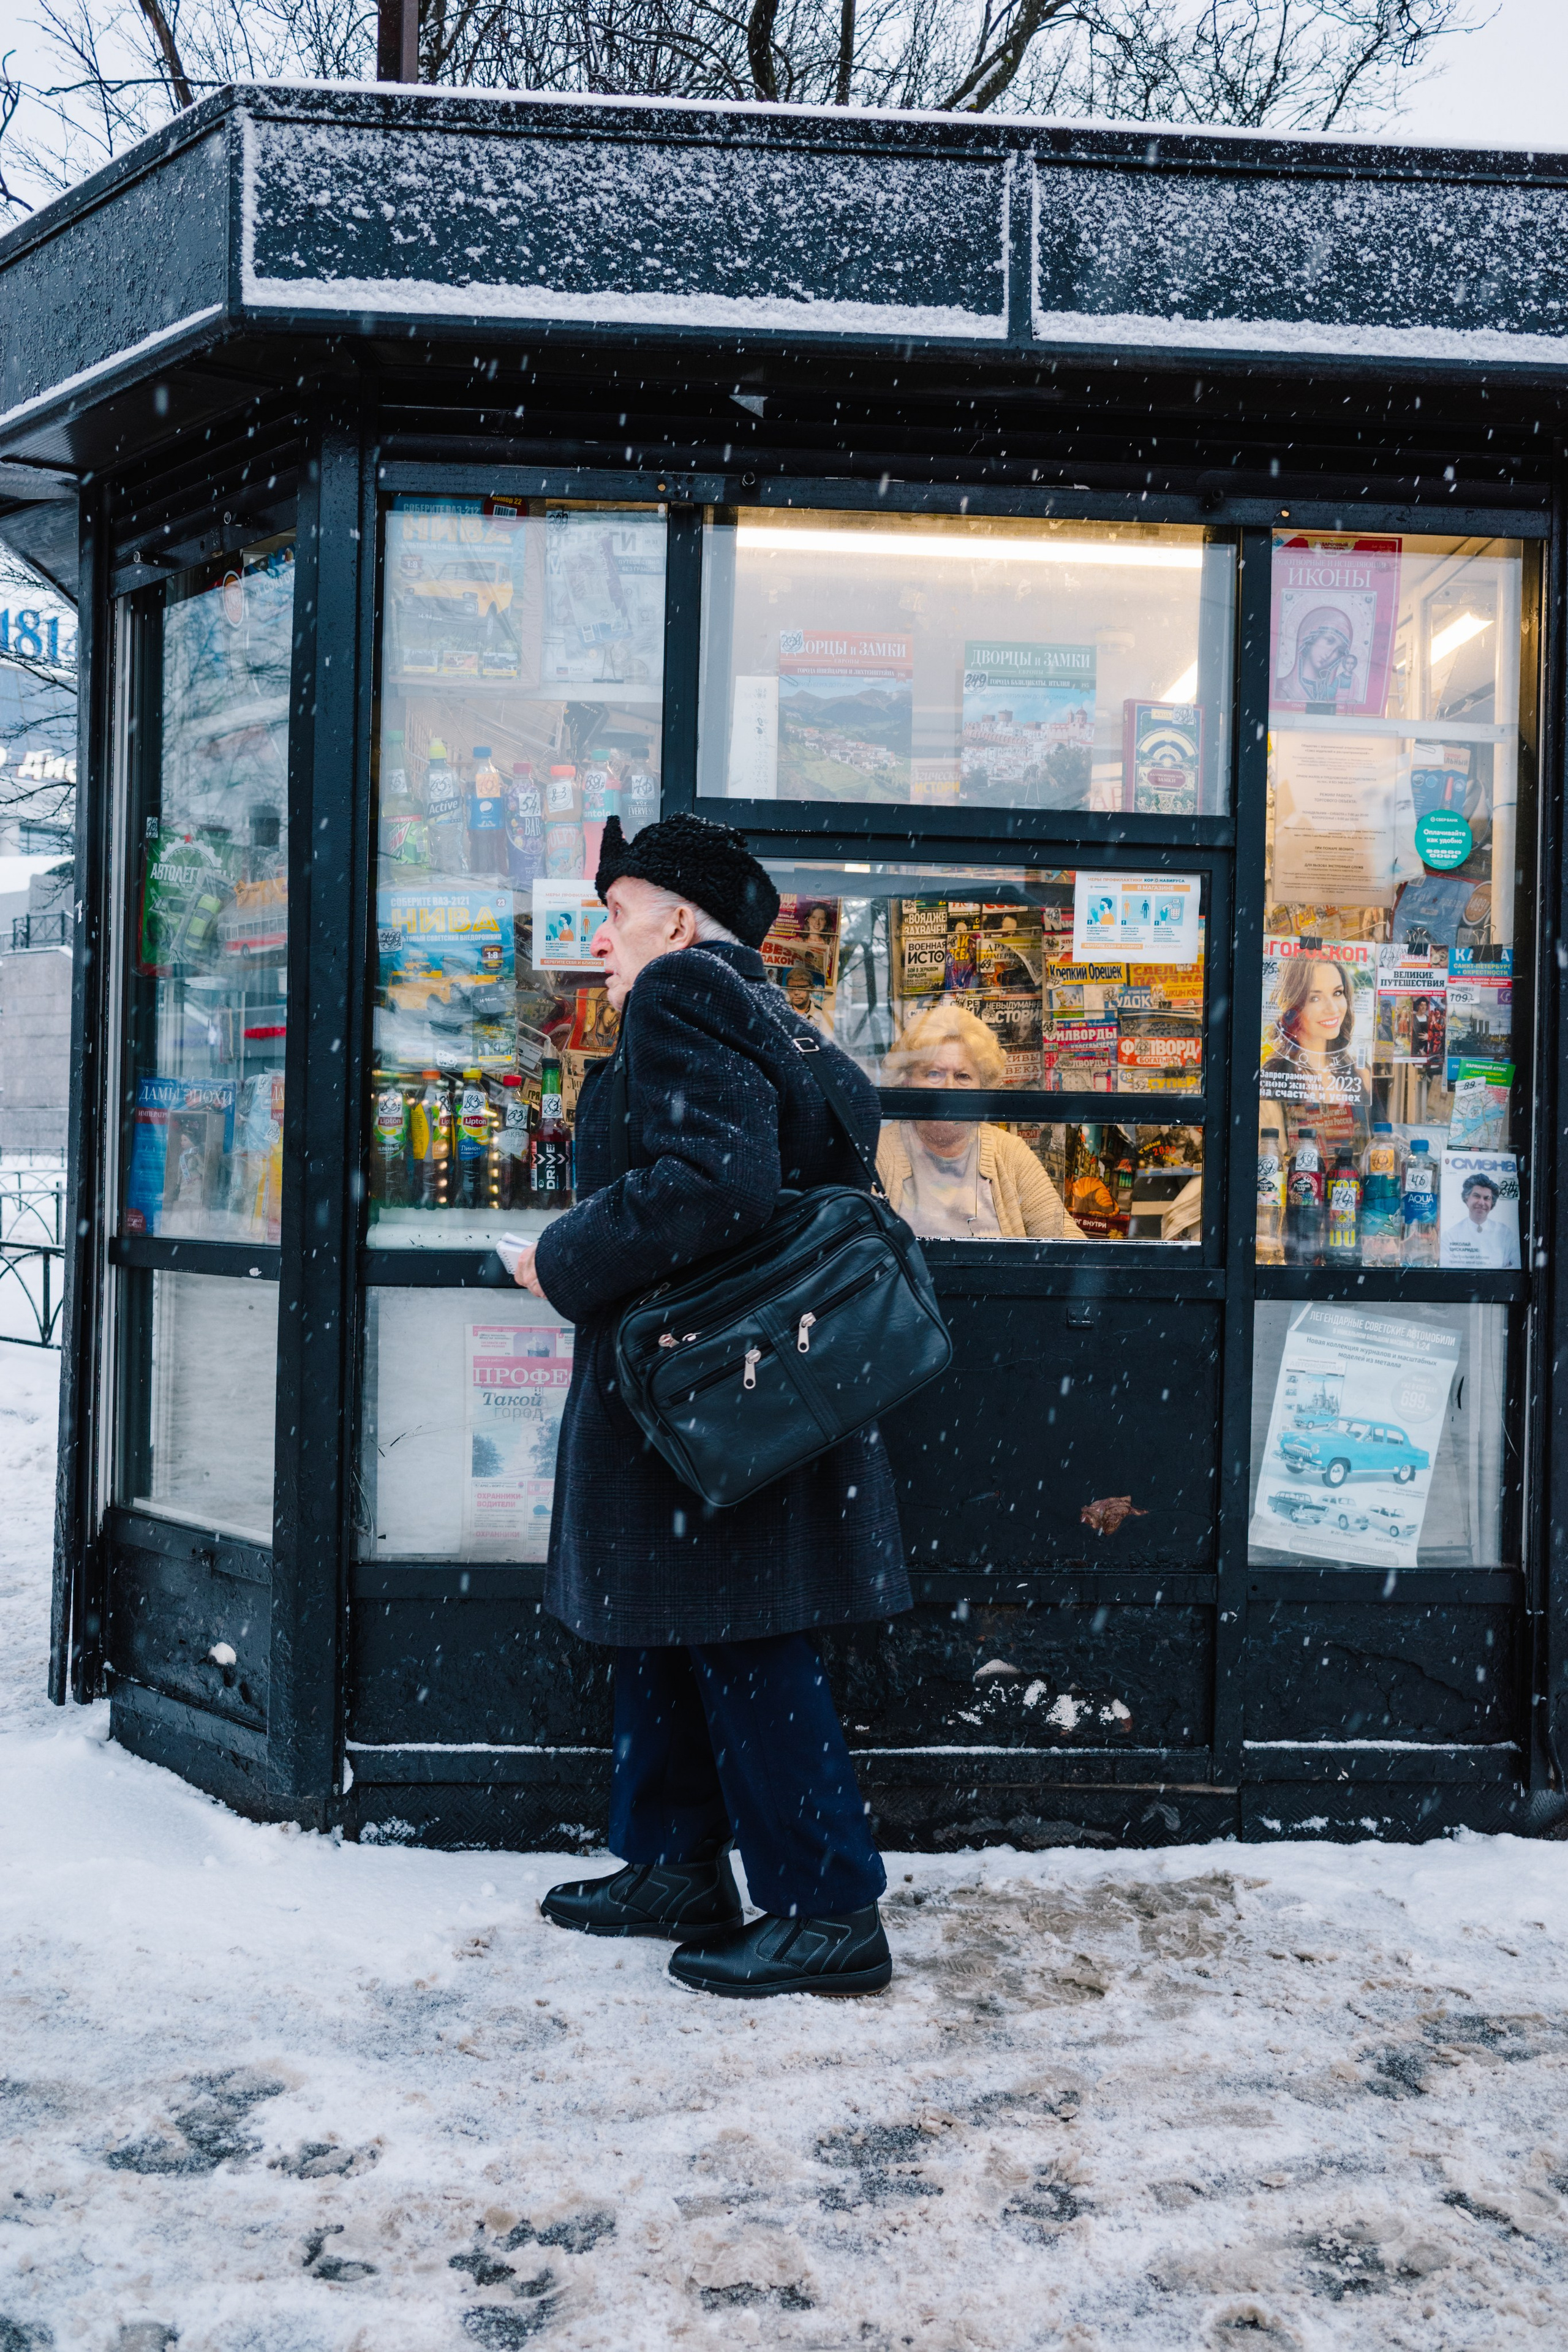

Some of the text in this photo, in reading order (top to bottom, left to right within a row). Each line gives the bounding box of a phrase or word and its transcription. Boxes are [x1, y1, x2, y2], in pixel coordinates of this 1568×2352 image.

[404, 503, 443, 511] СОБЕРИТЕ
[403, 514, 511, 544] НИВА
[1287, 567, 1371, 588] ИКОНЫ
[786, 641, 847, 658] ОРЦЫ
[859, 642, 907, 658] ЗАМКИ
[971, 650, 1031, 668] ДВОРЦЫ
[1044, 652, 1091, 668] ЗАМКИ
[429, 800, 458, 815] Active
[628, 807, 654, 816] EVERVESS
[391, 896, 470, 907] СОБЕРИТЕ ВАЗ-2121
[391, 907, 500, 933] НИВА
[904, 911, 947, 924] «ВОЯДЖЕ
[426, 933, 459, 942] СОВЕТСКИЙ
[908, 941, 947, 951] ВОЕННАЯ
[1269, 940, 1367, 962] ГОРОСКОП
[1455, 949, 1510, 962] КАА
[1050, 963, 1122, 982] Крепкий Орешек
[995, 1009, 1042, 1023] СТОРИ
[1005, 1066, 1039, 1074] ВЕКА
[1260, 1069, 1322, 1083] Запрограммируй
[1148, 1076, 1197, 1089] СУПЕР
[1289, 1082, 1324, 1091] жизнь
[1326, 1075, 1362, 1093] 2023
[139, 1085, 233, 1105] ДАМЫ ЭПОХИ
[1275, 1088, 1315, 1099] счастье
[1330, 1093, 1360, 1104] успех
[1153, 1145, 1176, 1156] 2023
[546, 1144, 557, 1189] DRIVE
[1412, 1174, 1425, 1186] 46
[1408, 1194, 1434, 1205] AQUA
[1083, 1219, 1107, 1229] ВНУТРИ
[1310, 1311, 1456, 1346] ЛЕГЕНДАРНЫЕ СОВЕТСКИЕ АВТОМОБИЛИ
[1337, 1329, 1366, 1340] УНИКАЛЬНОМ
[1366, 1335, 1389, 1343] БОЛЬШОМ
[1416, 1341, 1430, 1351] 1:24
[1306, 1336, 1325, 1346] Новая
[1326, 1341, 1359, 1352] коллекция
[1360, 1348, 1392, 1359] журналов
[1398, 1354, 1437, 1366] масштабных
[1289, 1360, 1343, 1371] АВТОМОБИЛИ
[1338, 1352, 1365, 1362] моделей
[1374, 1359, 1401, 1368] металла
[473, 1368, 571, 1385] ПРОФЕ
[483, 1392, 542, 1406] Такой
[1401, 1390, 1427, 1409] 699
[495, 1408, 543, 1422] город
